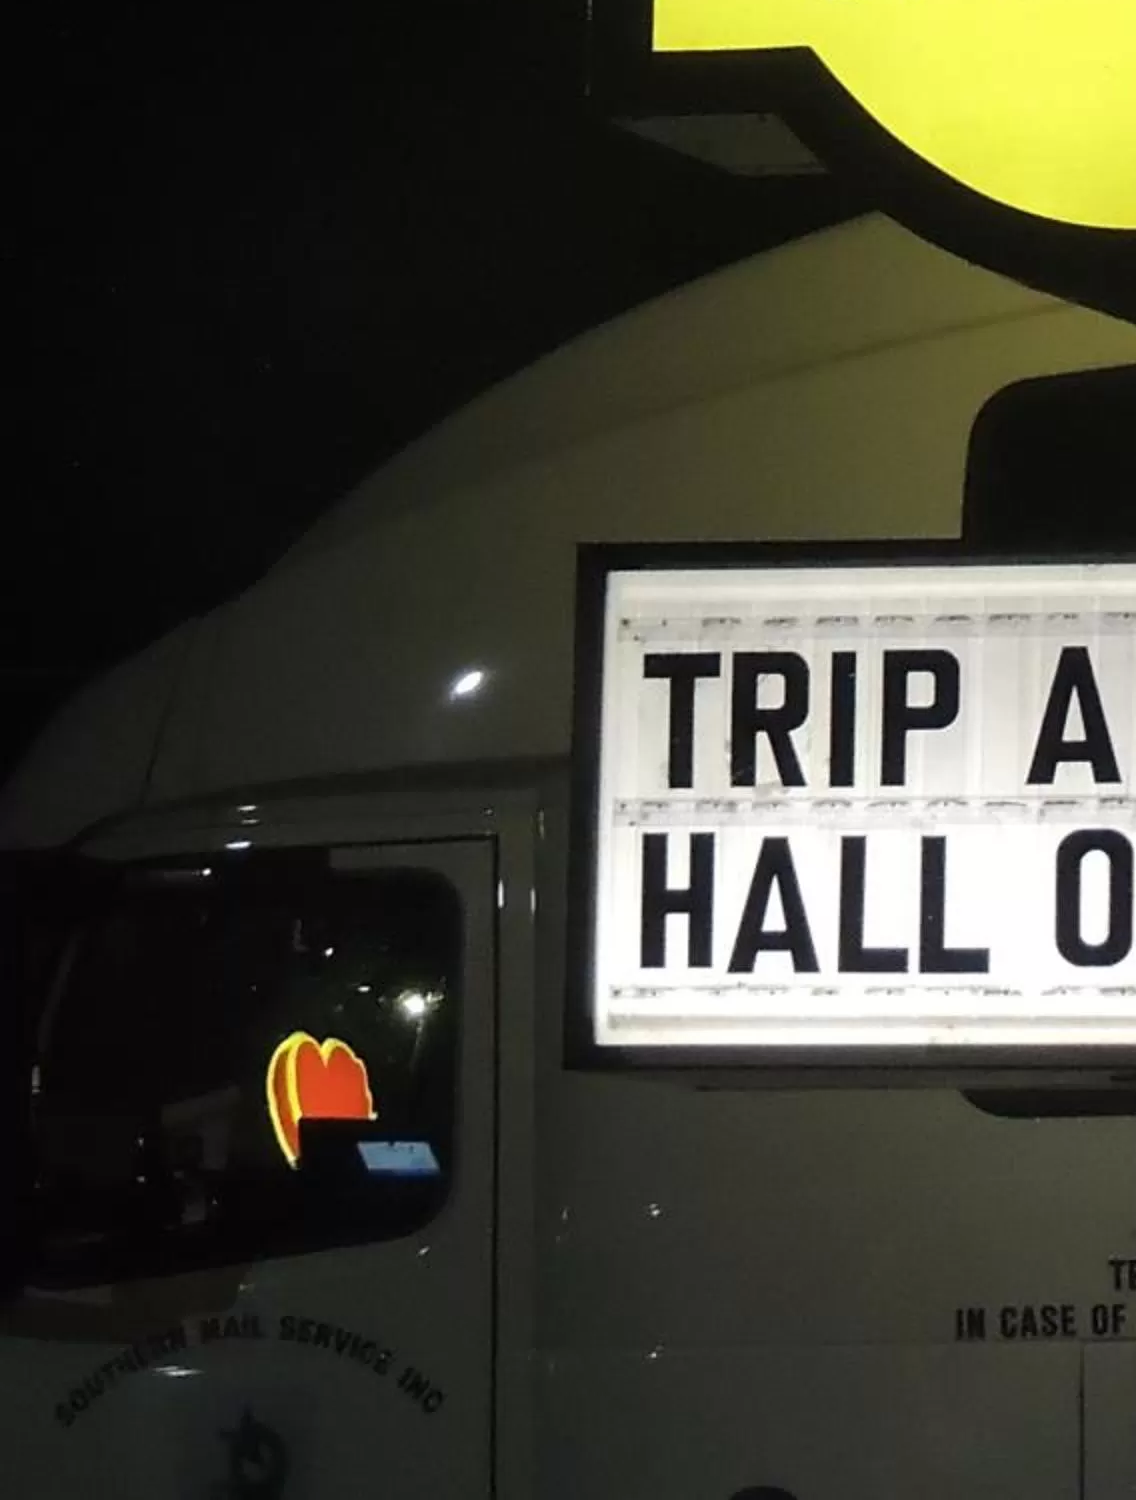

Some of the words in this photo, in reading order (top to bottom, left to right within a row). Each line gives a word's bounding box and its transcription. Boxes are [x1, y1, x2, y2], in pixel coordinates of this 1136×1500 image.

[642, 648, 961, 789] TRIP
[638, 831, 991, 974] HALL
[200, 1313, 263, 1344] MAIL
[279, 1314, 390, 1376] SERVICE
[397, 1366, 444, 1414] INC
[956, 1308, 986, 1341] IN
[1002, 1305, 1077, 1338] CASE
[1091, 1303, 1127, 1336] OF
